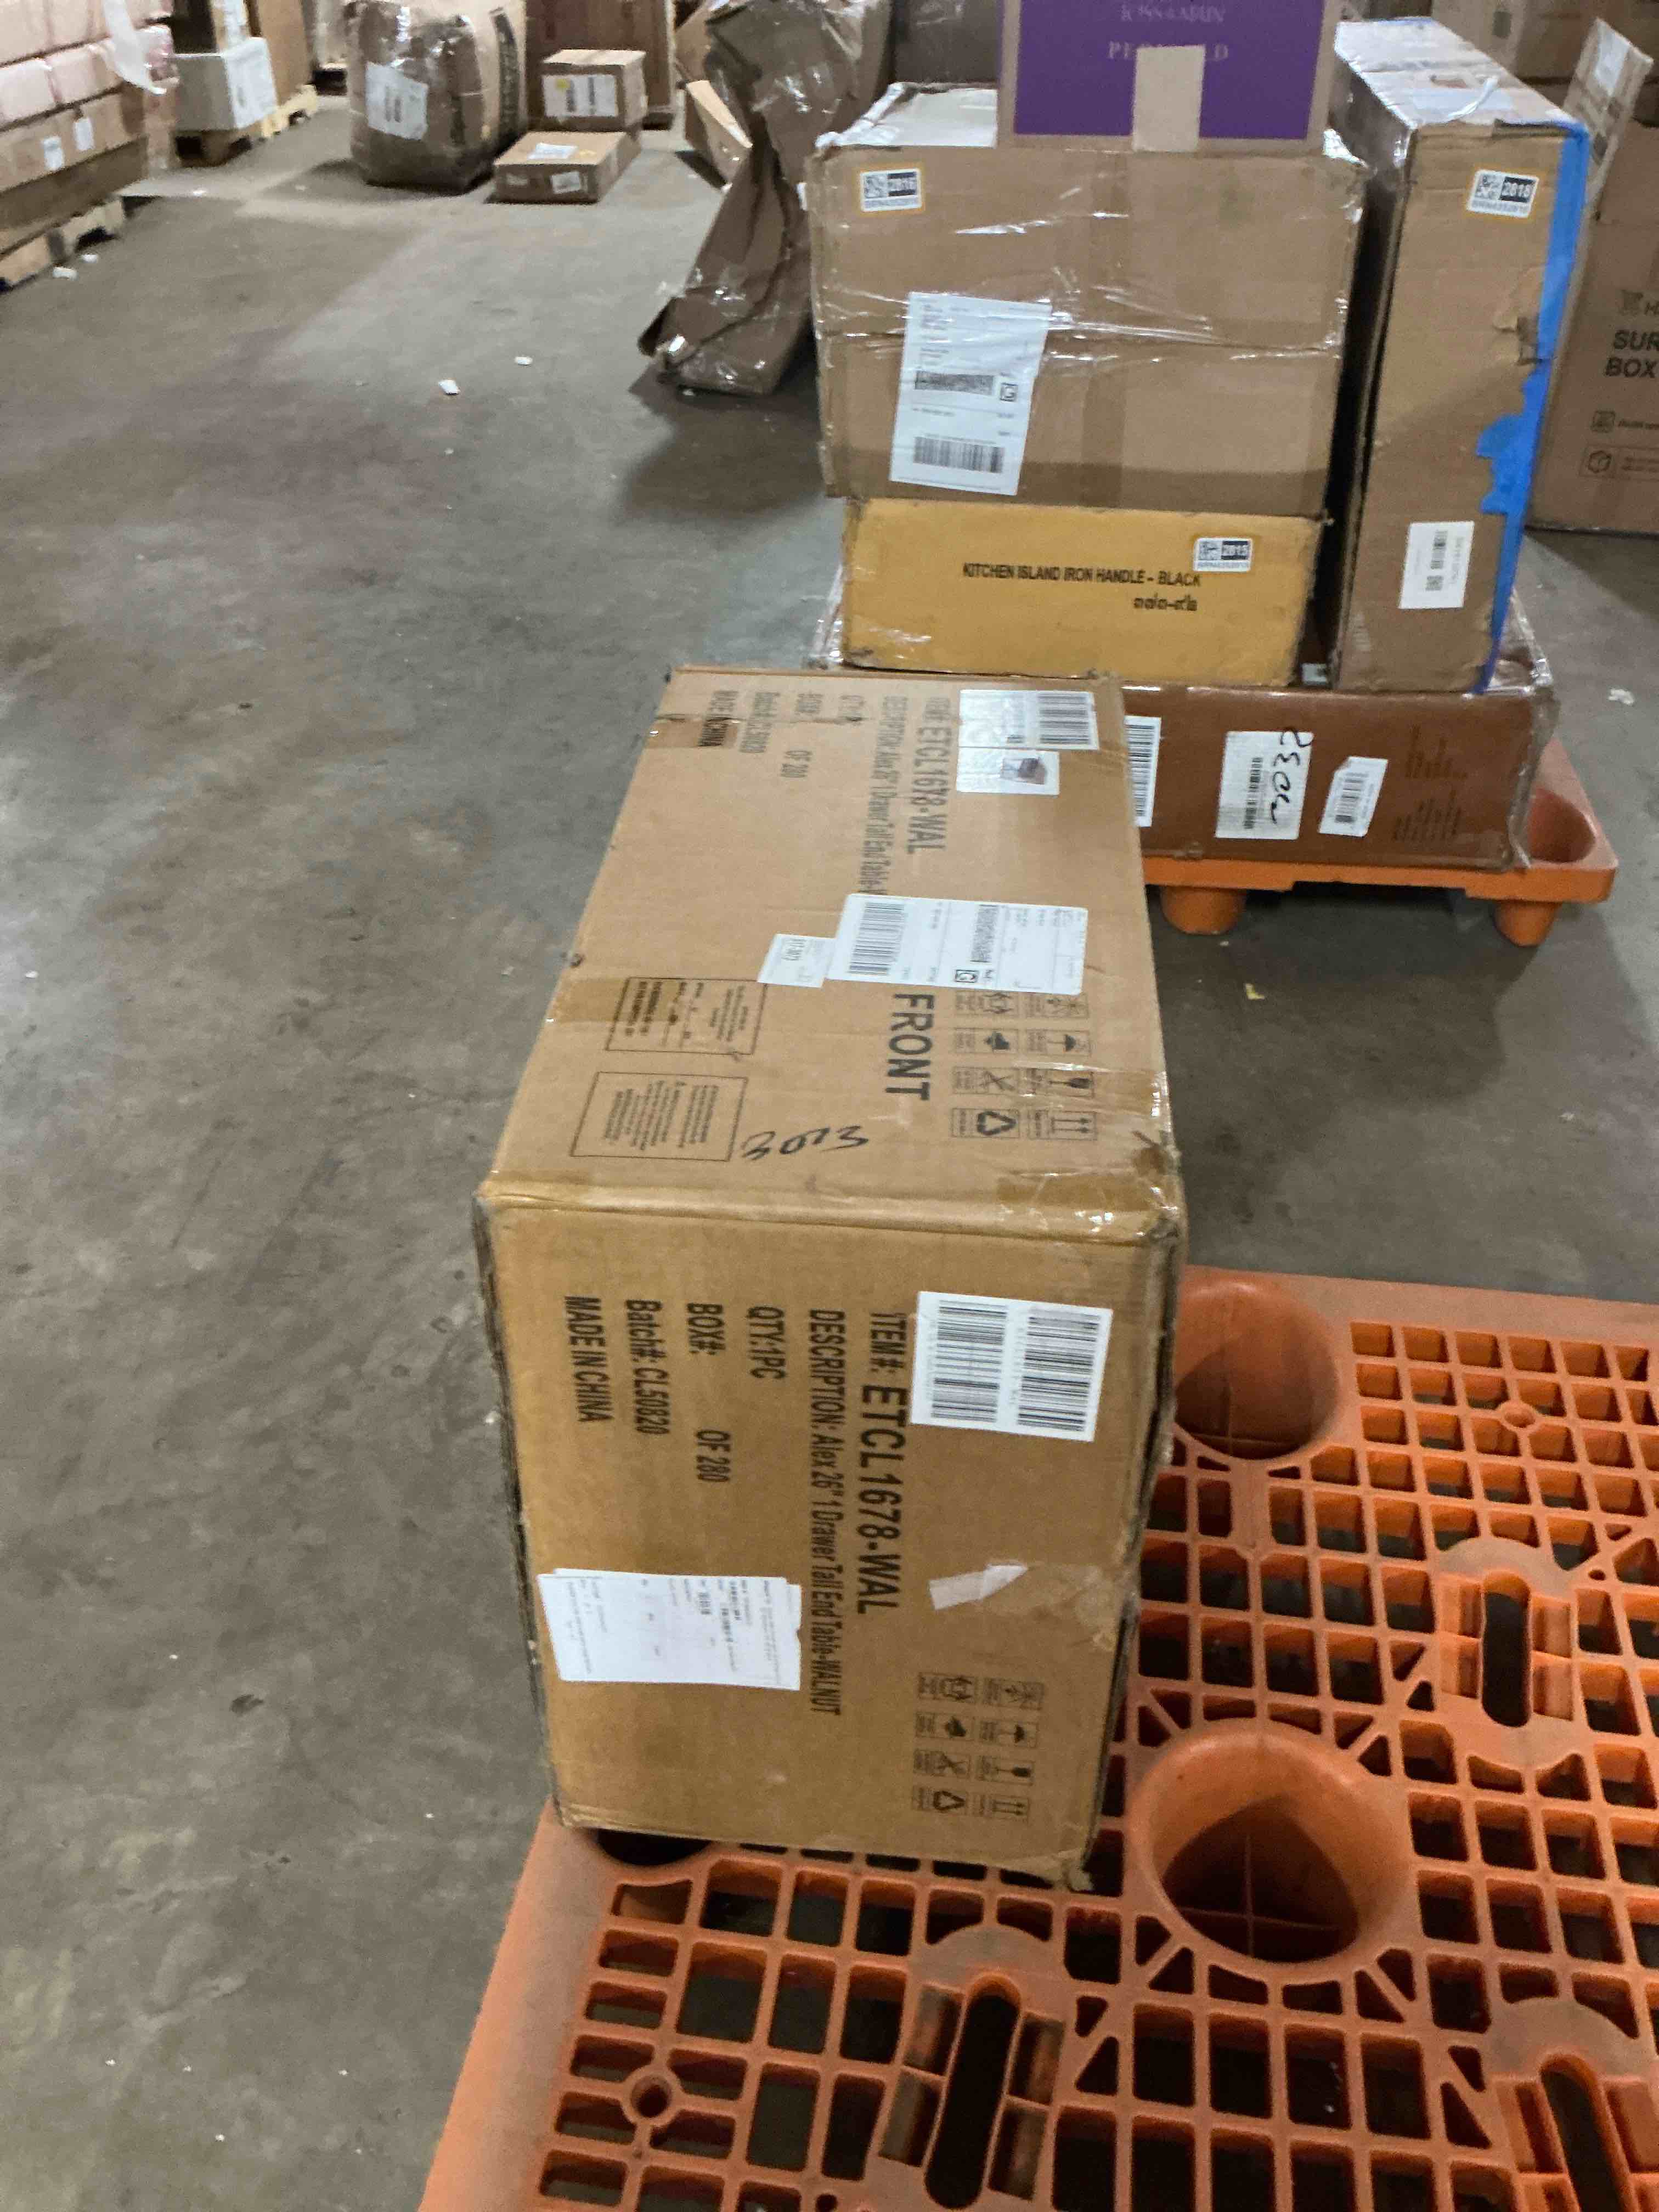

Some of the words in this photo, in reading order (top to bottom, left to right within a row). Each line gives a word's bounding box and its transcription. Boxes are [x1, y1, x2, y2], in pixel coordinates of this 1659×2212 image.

[1605, 357, 1656, 378] BOX
[963, 562, 1014, 578] KITCHEN
[1018, 565, 1060, 580] ISLAND
[1064, 566, 1093, 582] IRON
[1097, 568, 1145, 584] HANDLE
[1158, 570, 1201, 587] BLACK
[884, 994, 935, 1101] FRONT
[564, 1295, 606, 1347] MADE
[570, 1350, 609, 1367] IN
[809, 1310, 846, 1430] DESCRIPTION:
[575, 1370, 614, 1423] CHINA
[693, 1427, 732, 1453] OF
[810, 1432, 845, 1468] Alex
[696, 1454, 731, 1482] 280
[811, 1509, 845, 1562] Drawer
[811, 1564, 844, 1589] Tall
[811, 1590, 844, 1617] End
